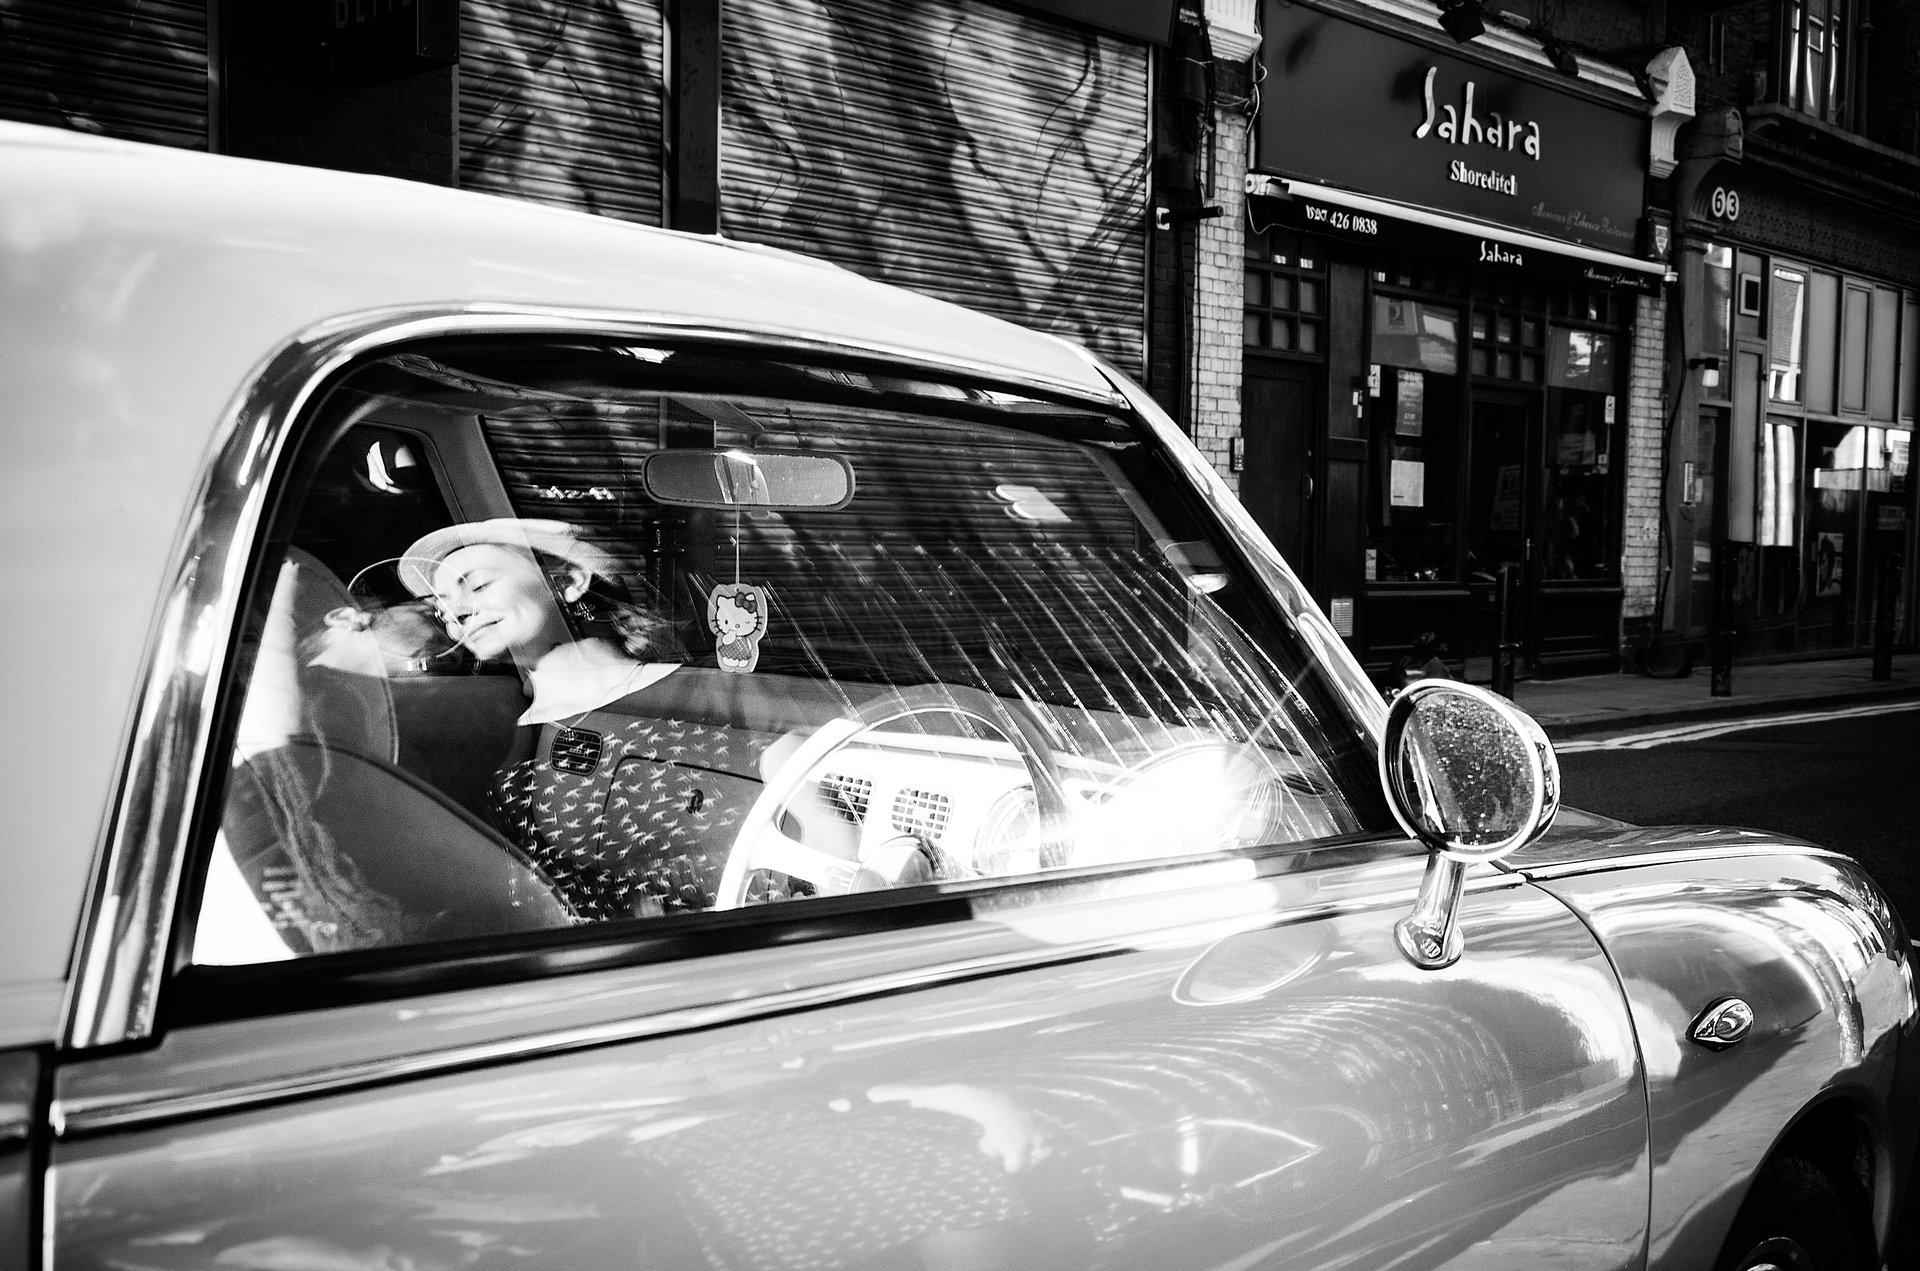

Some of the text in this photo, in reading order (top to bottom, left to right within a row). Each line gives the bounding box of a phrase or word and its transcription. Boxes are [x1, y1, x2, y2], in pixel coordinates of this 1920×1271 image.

[1416, 66, 1541, 161] Sahara
[1450, 159, 1518, 196] Shoreditch
[1714, 190, 1738, 218] 63
[1329, 211, 1350, 230] 426
[1352, 215, 1378, 235] 0838
[1479, 241, 1523, 267] Sahara
